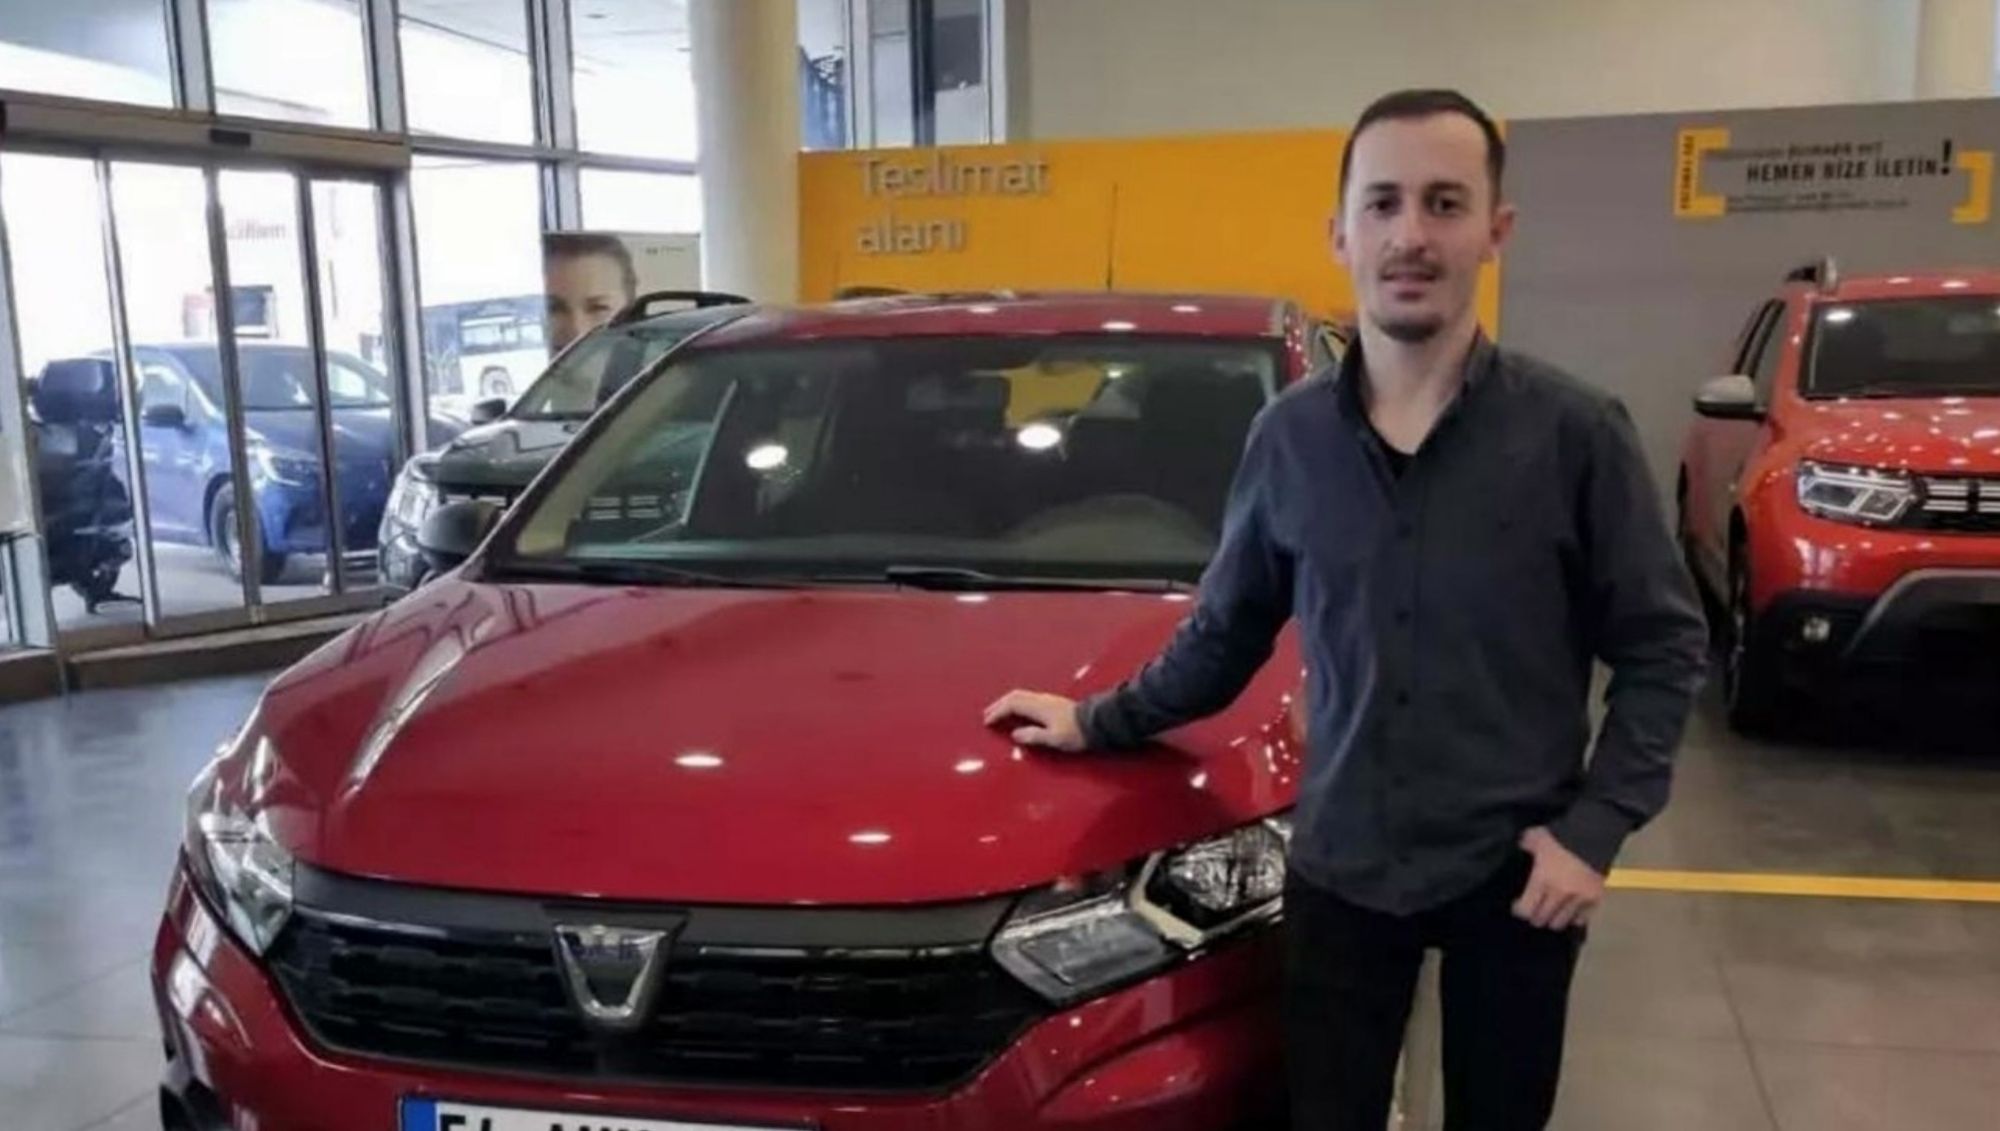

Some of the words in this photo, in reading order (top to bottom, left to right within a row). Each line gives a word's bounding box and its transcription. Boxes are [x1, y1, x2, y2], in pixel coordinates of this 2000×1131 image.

[860, 152, 1050, 196] Teslimat
[1747, 161, 1815, 183] HEMEN
[1823, 157, 1870, 180] BİZE
[857, 213, 967, 254] alanı
